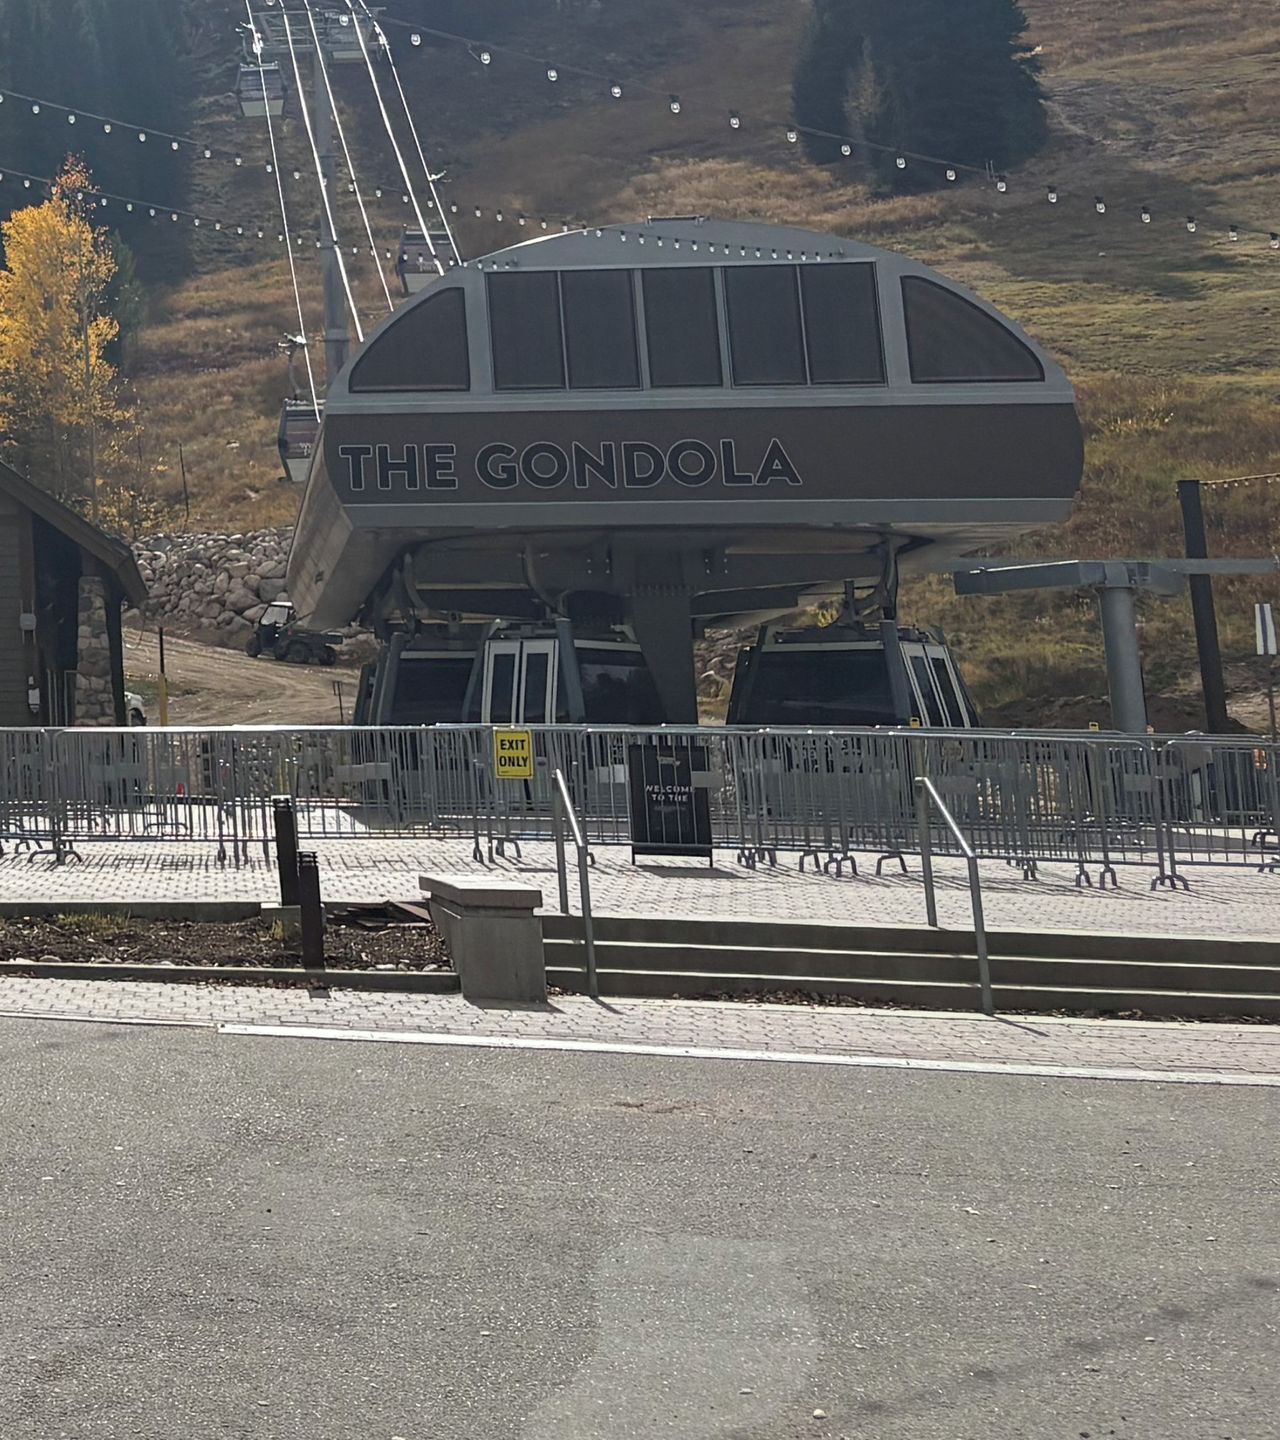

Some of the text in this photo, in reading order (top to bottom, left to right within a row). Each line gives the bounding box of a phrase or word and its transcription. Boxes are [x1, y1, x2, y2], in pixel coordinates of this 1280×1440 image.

[339, 438, 803, 490] THE GONDOLA
[500, 739, 526, 751] EXIT
[499, 755, 528, 768] ONLY
[651, 793, 688, 802] TO THE
